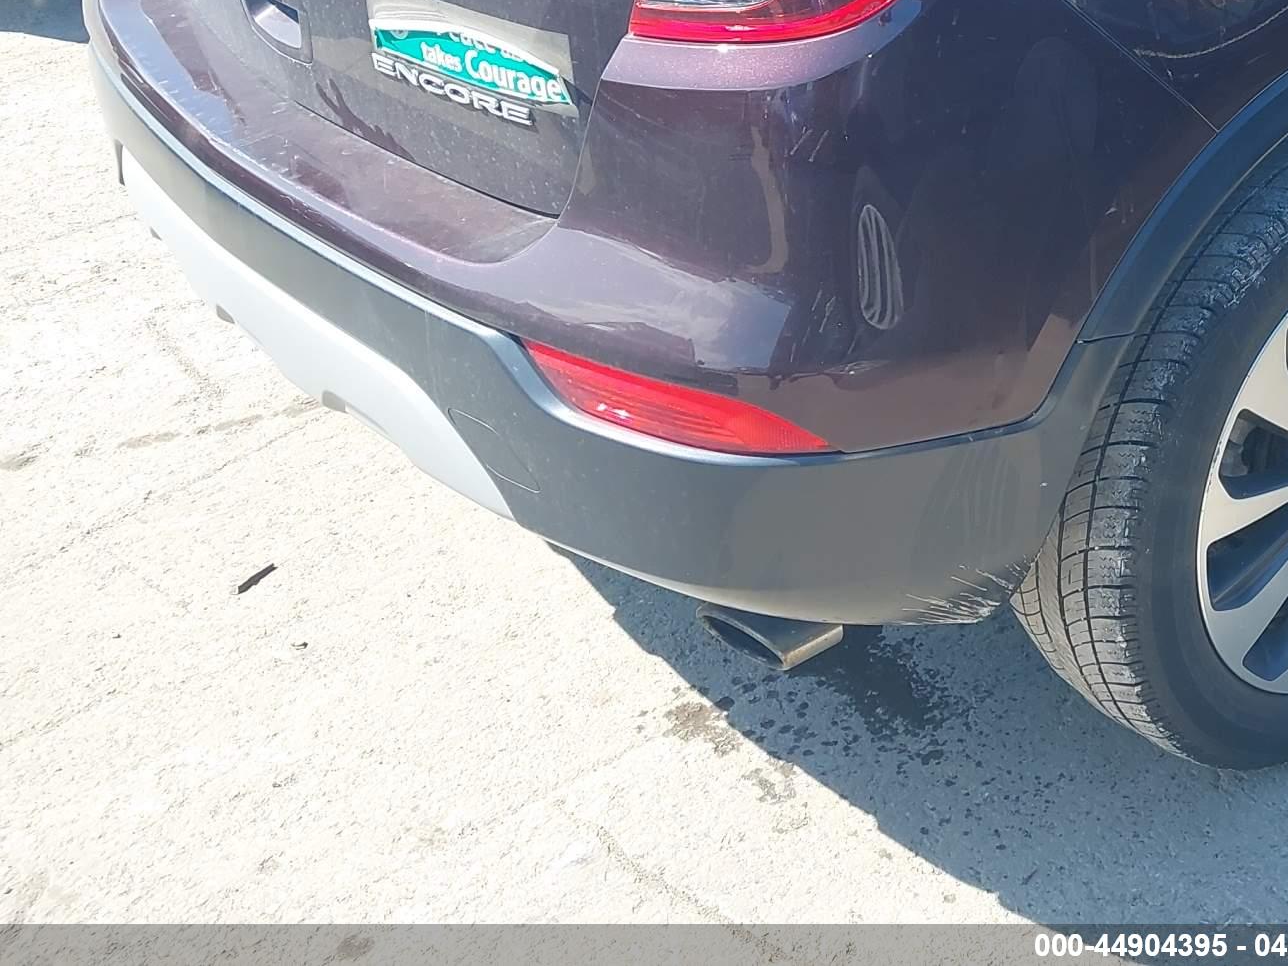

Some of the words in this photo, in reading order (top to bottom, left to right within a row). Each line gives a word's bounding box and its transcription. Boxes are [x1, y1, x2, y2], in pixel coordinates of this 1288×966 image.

[370, 52, 533, 126] ENCORE
[421, 42, 463, 72] takes
[464, 49, 563, 103] Courage
